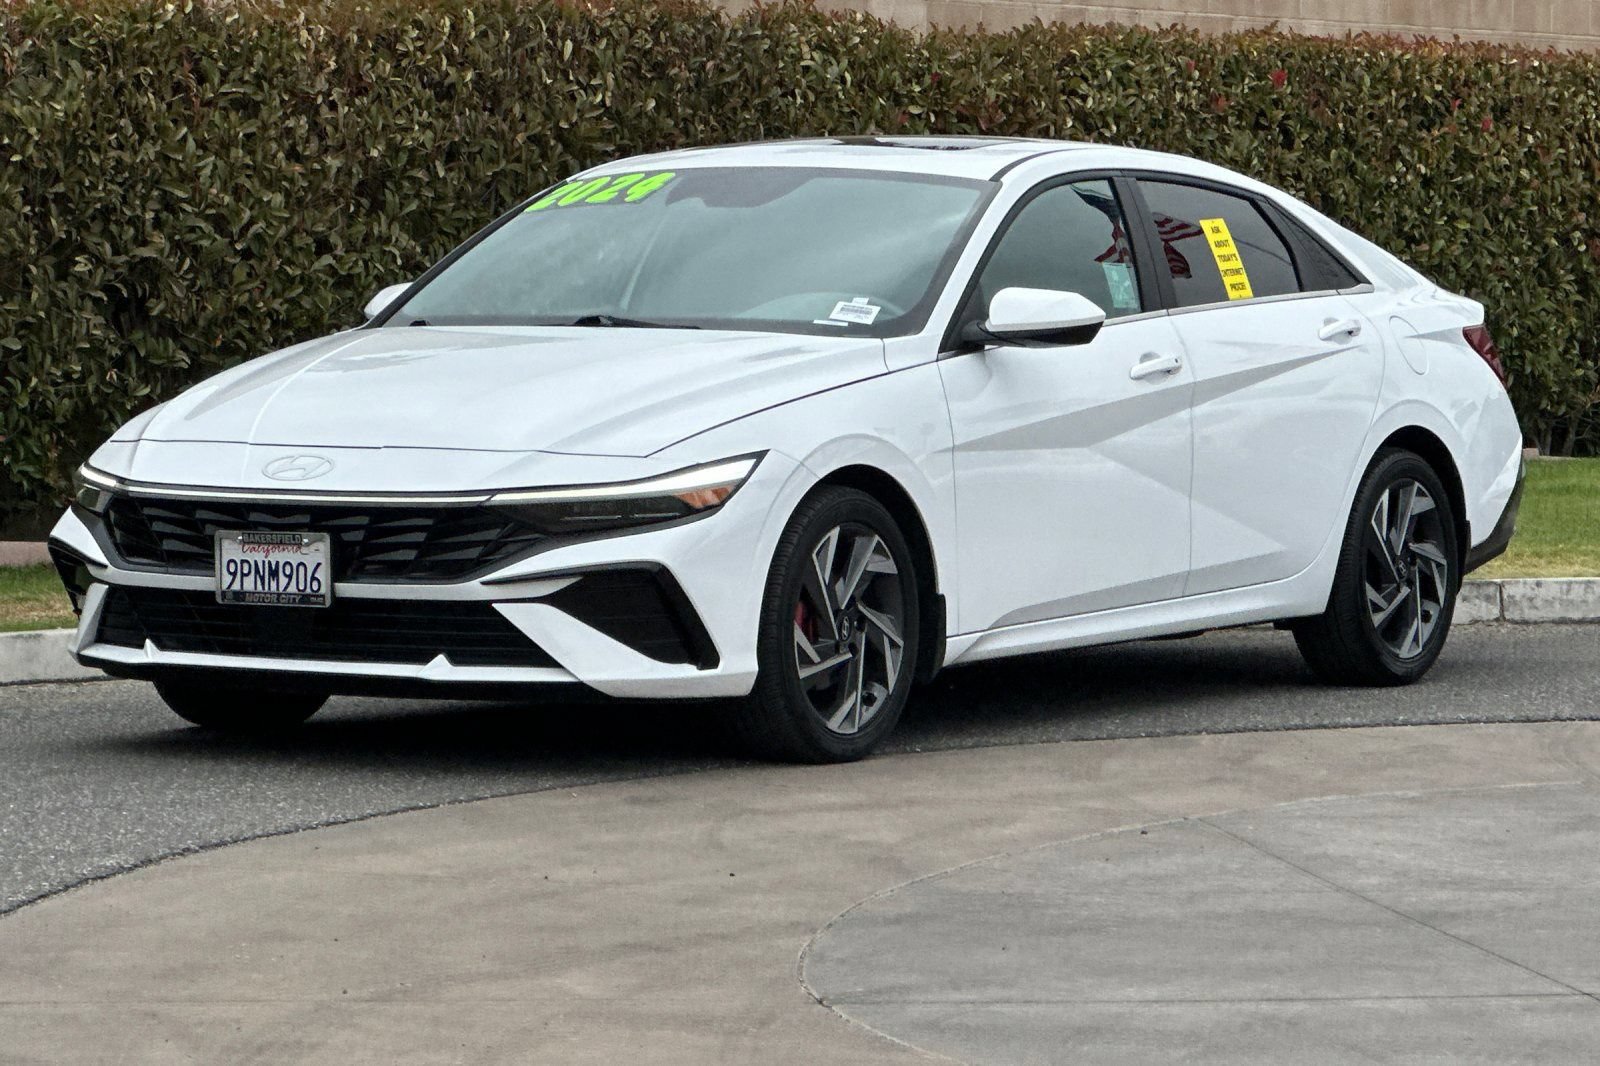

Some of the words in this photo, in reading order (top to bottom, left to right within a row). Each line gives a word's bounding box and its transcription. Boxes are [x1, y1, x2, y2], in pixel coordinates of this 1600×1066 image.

[524, 172, 676, 213] 2024
[1214, 239, 1230, 248] ABOUT
[1217, 253, 1238, 262] TODAY'S
[1221, 267, 1243, 277] INTERNET
[243, 534, 302, 543] BAKERSFIELD
[241, 543, 303, 558] California
[226, 558, 322, 593] 9PNM906
[245, 593, 278, 603] MOTOR
[279, 594, 303, 603] CITY
